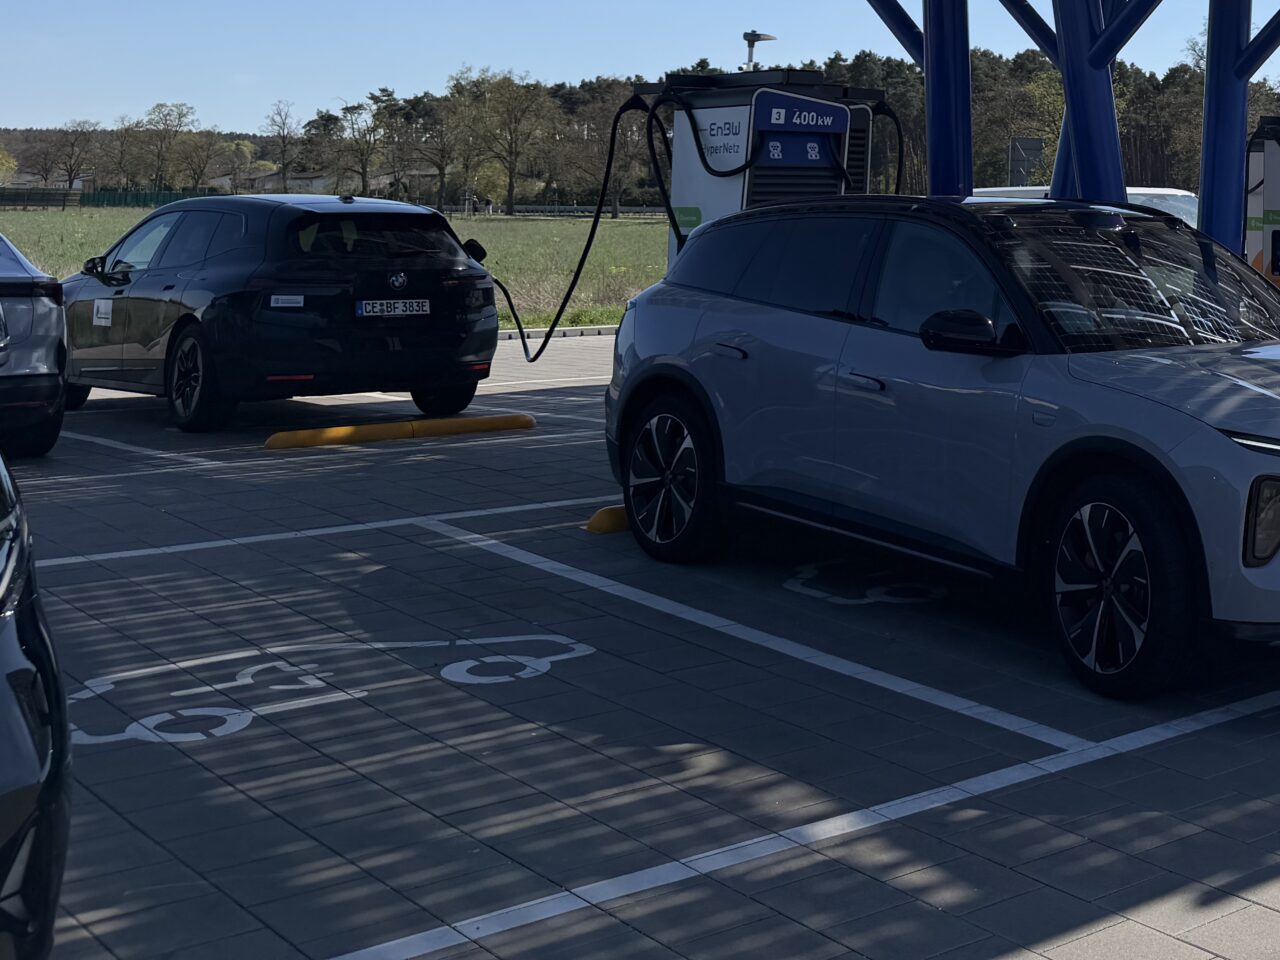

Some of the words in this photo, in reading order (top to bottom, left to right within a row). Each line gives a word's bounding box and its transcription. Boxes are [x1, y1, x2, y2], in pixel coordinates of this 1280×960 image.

[775, 111, 782, 121] 3
[709, 122, 741, 137] EnBW
[364, 302, 378, 314] CE
[386, 301, 399, 313] BF
[401, 301, 428, 313] 383E
